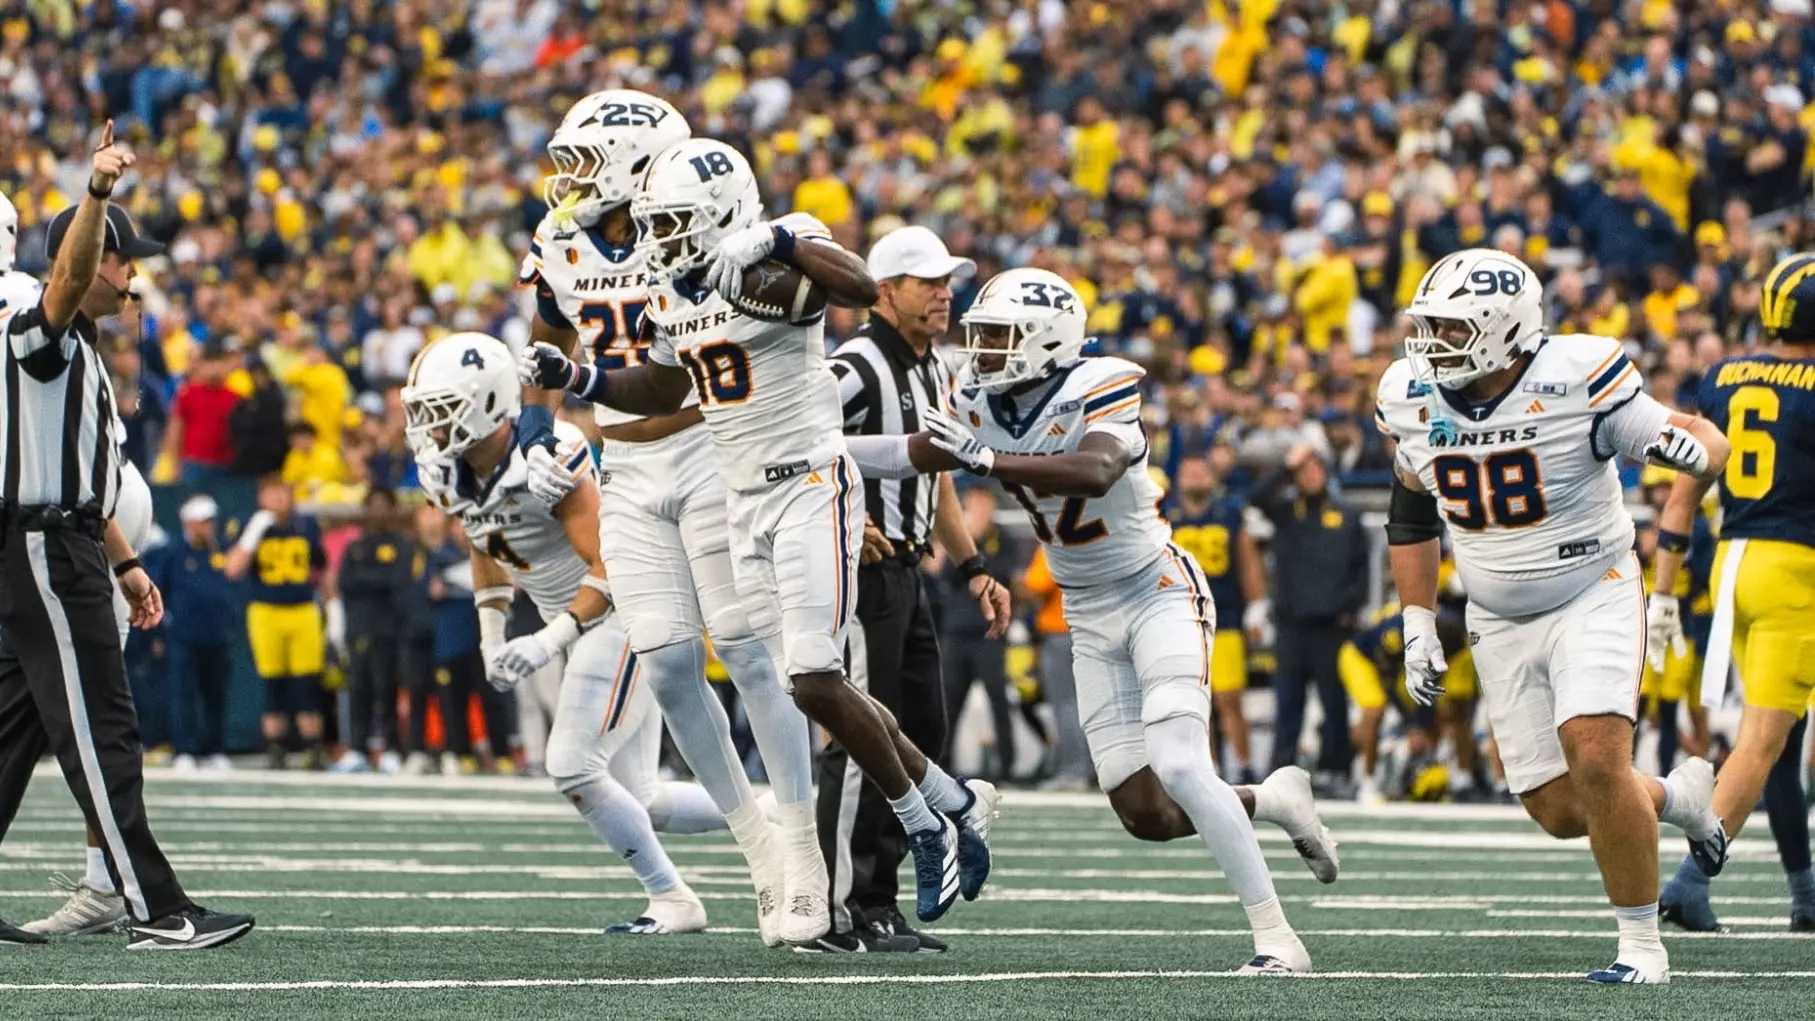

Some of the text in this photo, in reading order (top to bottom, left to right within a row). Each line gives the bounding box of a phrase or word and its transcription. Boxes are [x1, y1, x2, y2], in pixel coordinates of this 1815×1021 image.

[601, 103, 658, 129] 25
[689, 151, 734, 183] 18
[573, 272, 647, 292] MINER
[1471, 270, 1522, 297] 98
[1021, 282, 1073, 311] 32
[461, 348, 485, 370] 4
[677, 338, 754, 406] 18
[900, 392, 913, 411] S
[1725, 386, 1780, 501] 6
[1432, 448, 1547, 532] 98
